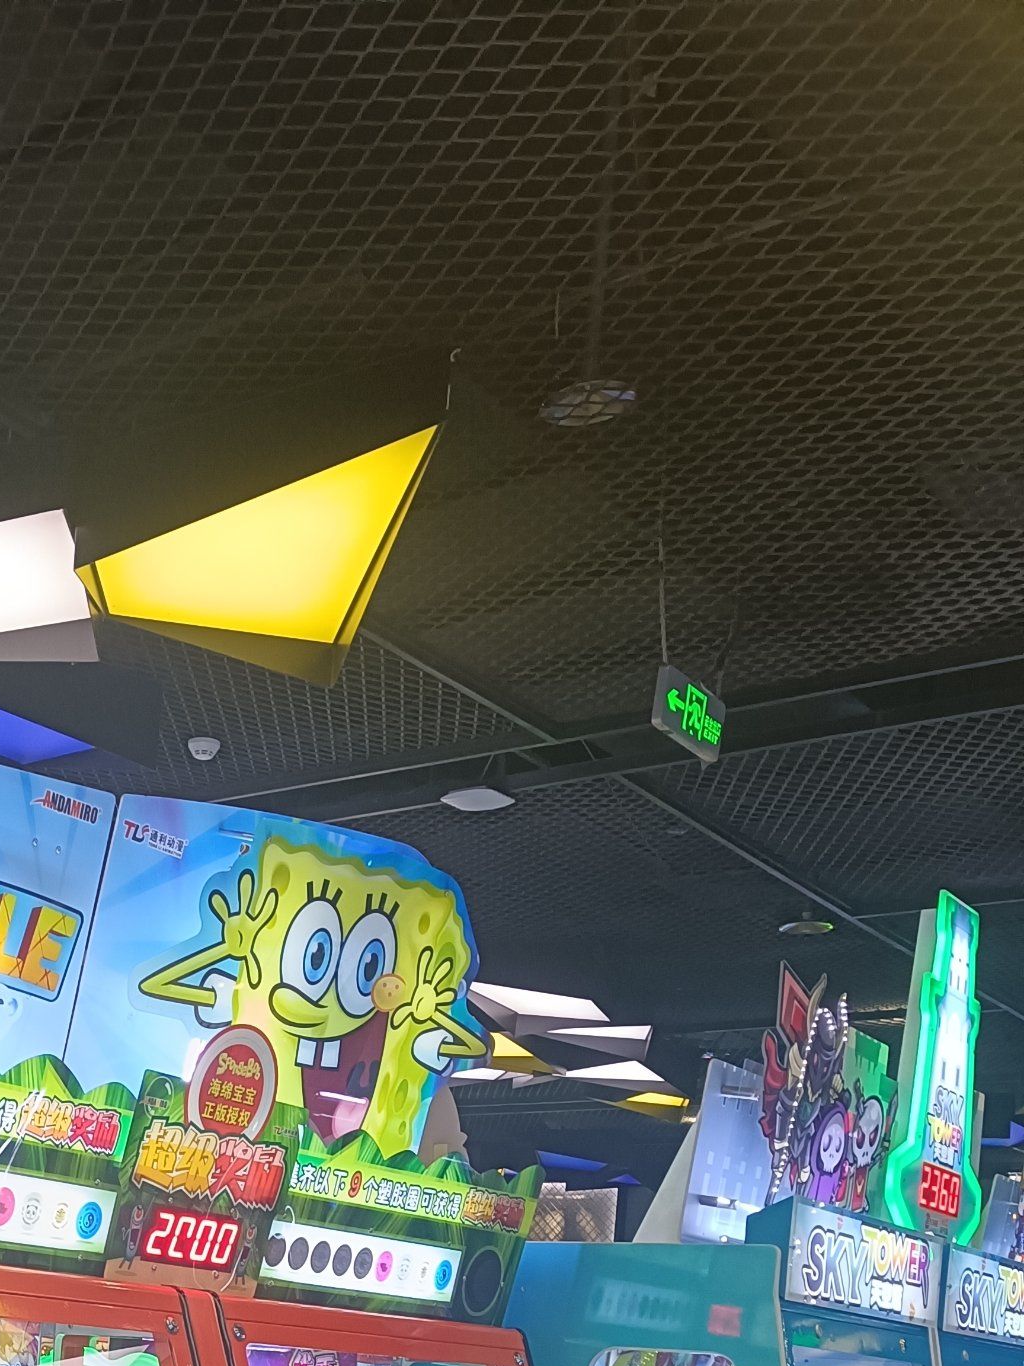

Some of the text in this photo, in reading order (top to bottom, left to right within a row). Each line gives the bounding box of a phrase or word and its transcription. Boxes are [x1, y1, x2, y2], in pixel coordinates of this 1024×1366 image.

[703, 728, 719, 745] EXIT
[33, 789, 99, 825] ANDAMIRO
[148, 829, 185, 853] 通利动漫
[207, 1078, 257, 1106] 海绵宝宝
[201, 1101, 252, 1128] 正版授权
[132, 1119, 287, 1212] 超级奖励
[920, 1165, 960, 1215] 2360
[802, 1223, 930, 1308] SKY TOWER
[955, 1267, 1004, 1336] SKY
